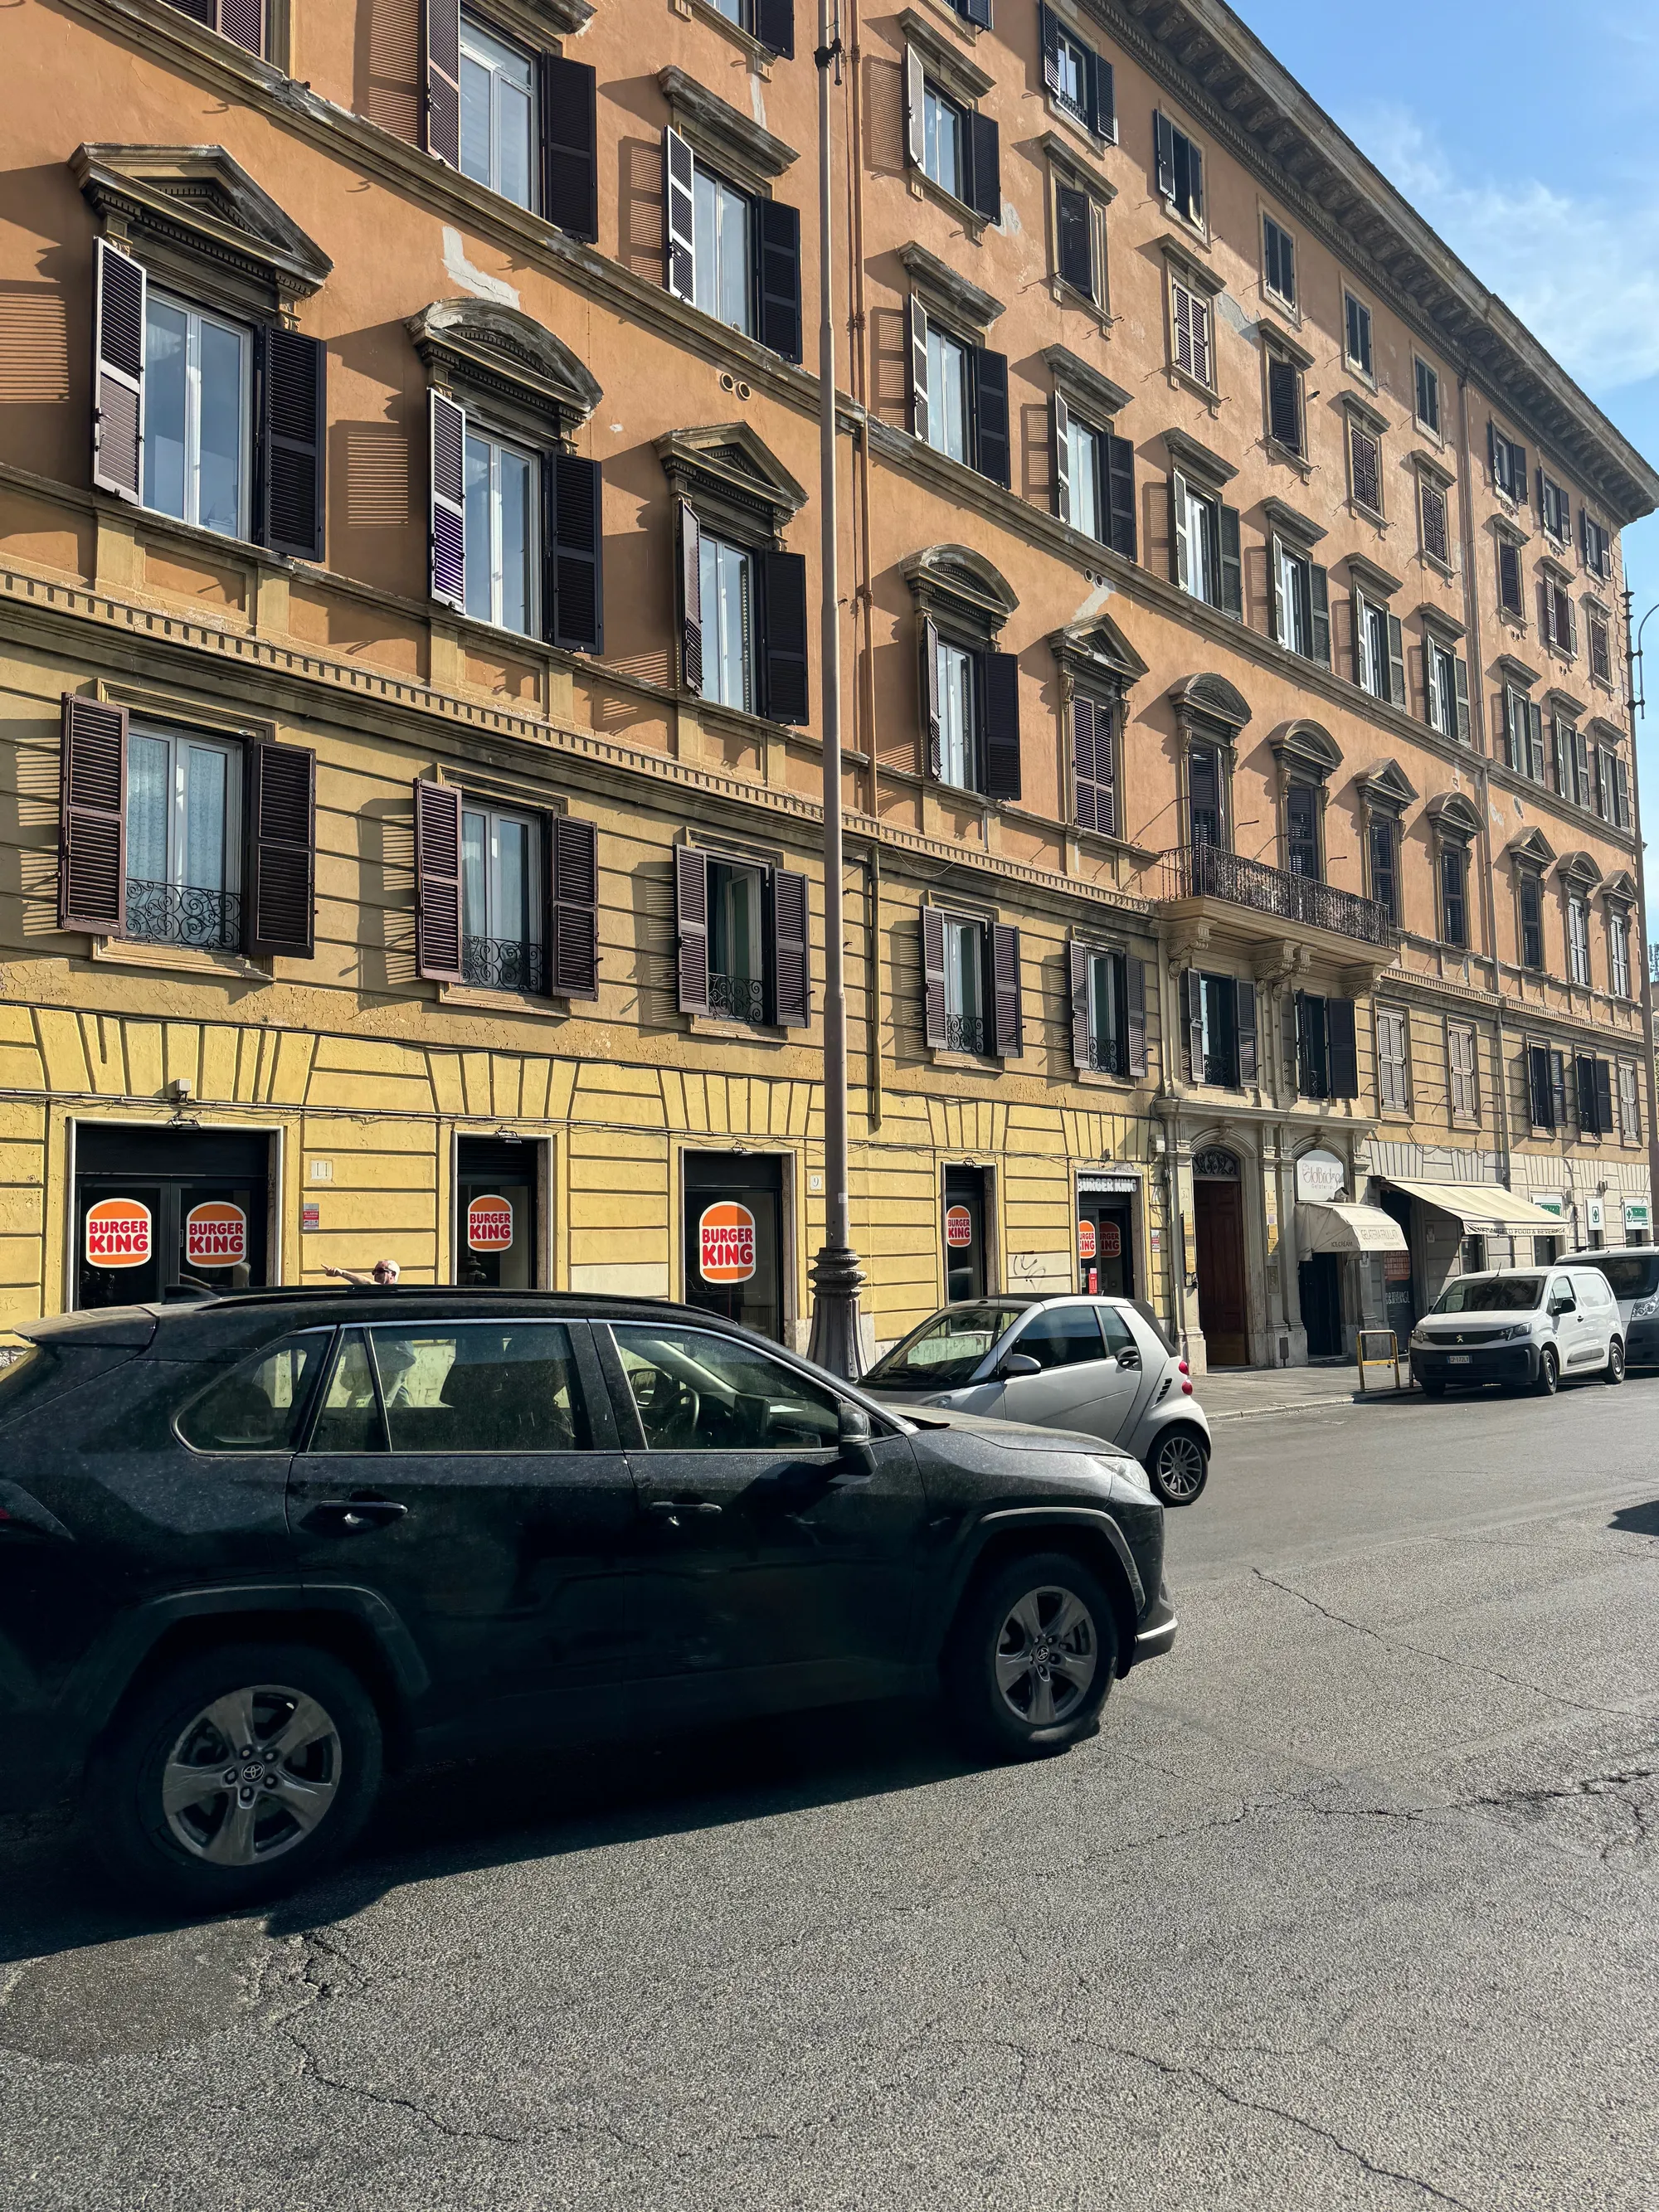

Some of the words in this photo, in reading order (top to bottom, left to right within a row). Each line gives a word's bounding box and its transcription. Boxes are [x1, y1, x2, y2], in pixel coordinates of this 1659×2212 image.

[813, 1176, 820, 1187] 9
[1078, 1178, 1114, 1192] BURGER
[1114, 1179, 1137, 1193] KING
[469, 1213, 511, 1224] BURGER
[948, 1218, 971, 1228] BURGER
[89, 1221, 148, 1234] BURGER
[189, 1223, 244, 1236] BURGER
[469, 1224, 511, 1240] KING
[948, 1227, 971, 1238] KING
[702, 1228, 753, 1243] BURGER
[89, 1234, 148, 1253] KING
[189, 1235, 244, 1254] KING
[1101, 1241, 1120, 1251] ING
[702, 1243, 753, 1266] KING
